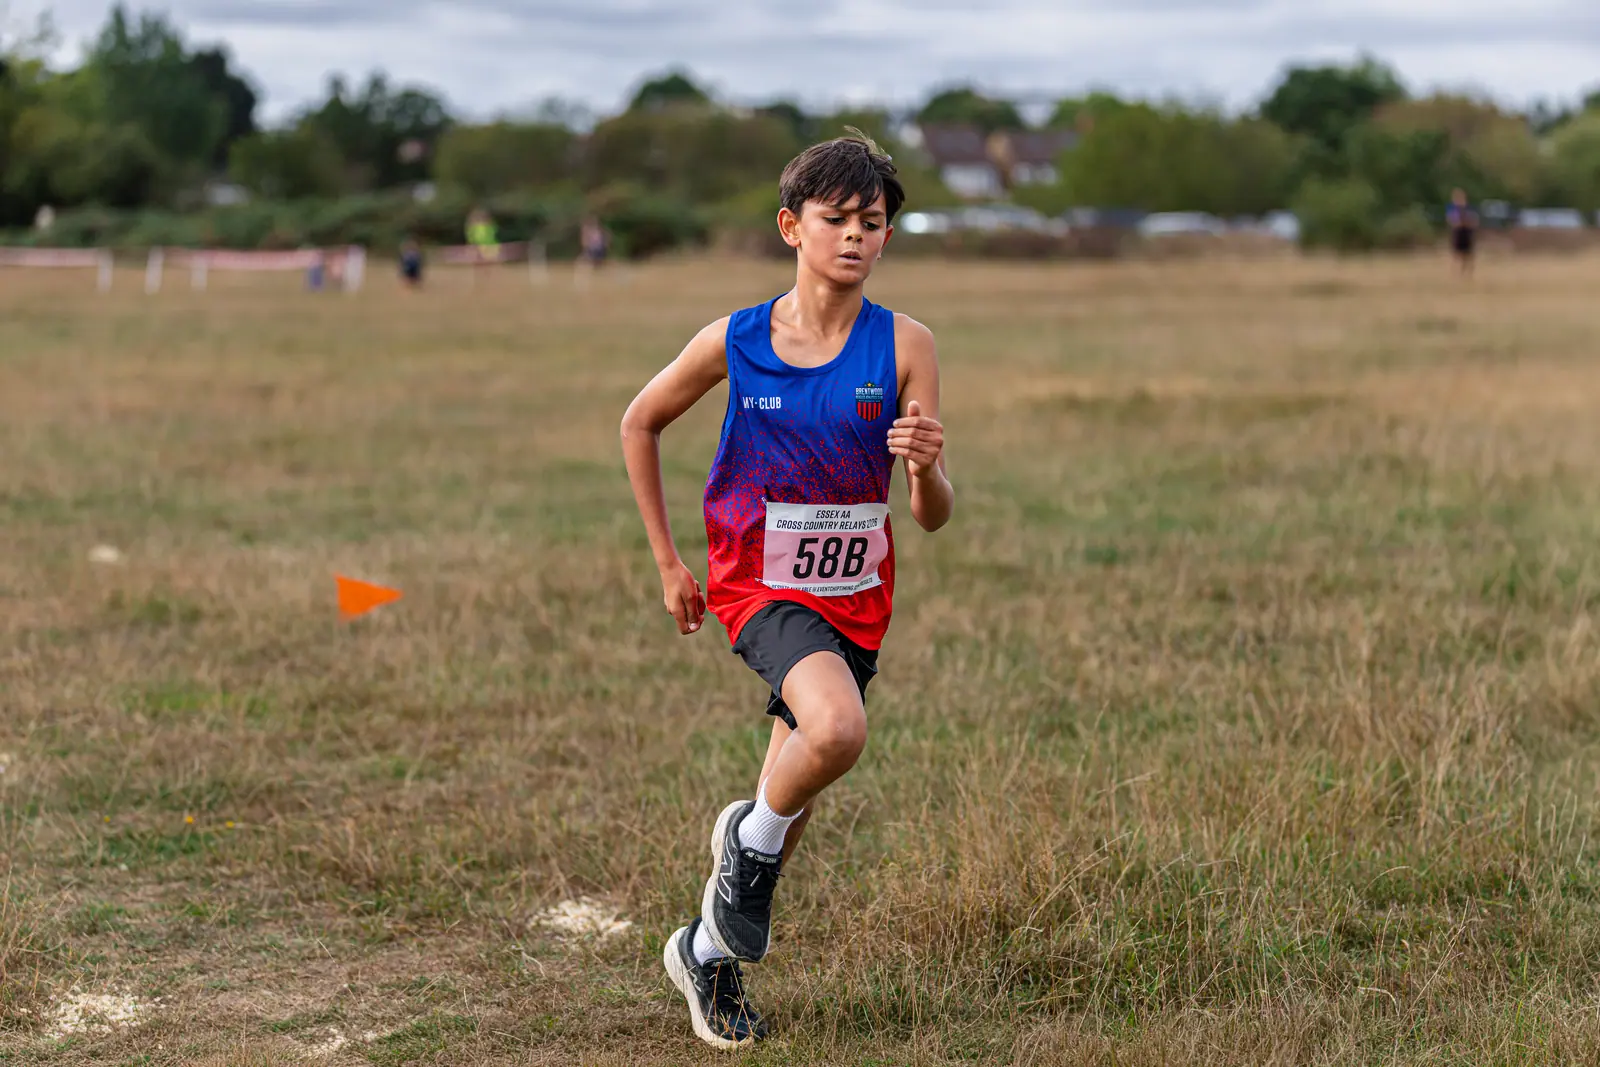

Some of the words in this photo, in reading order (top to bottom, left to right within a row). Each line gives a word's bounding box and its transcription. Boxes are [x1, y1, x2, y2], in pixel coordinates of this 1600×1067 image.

[815, 509, 839, 519] ESSEX
[840, 510, 851, 519] AA
[776, 519, 803, 530] CROSS
[803, 520, 839, 530] COUNTRY
[838, 519, 866, 530] RELAYS
[792, 536, 869, 579] 58B
